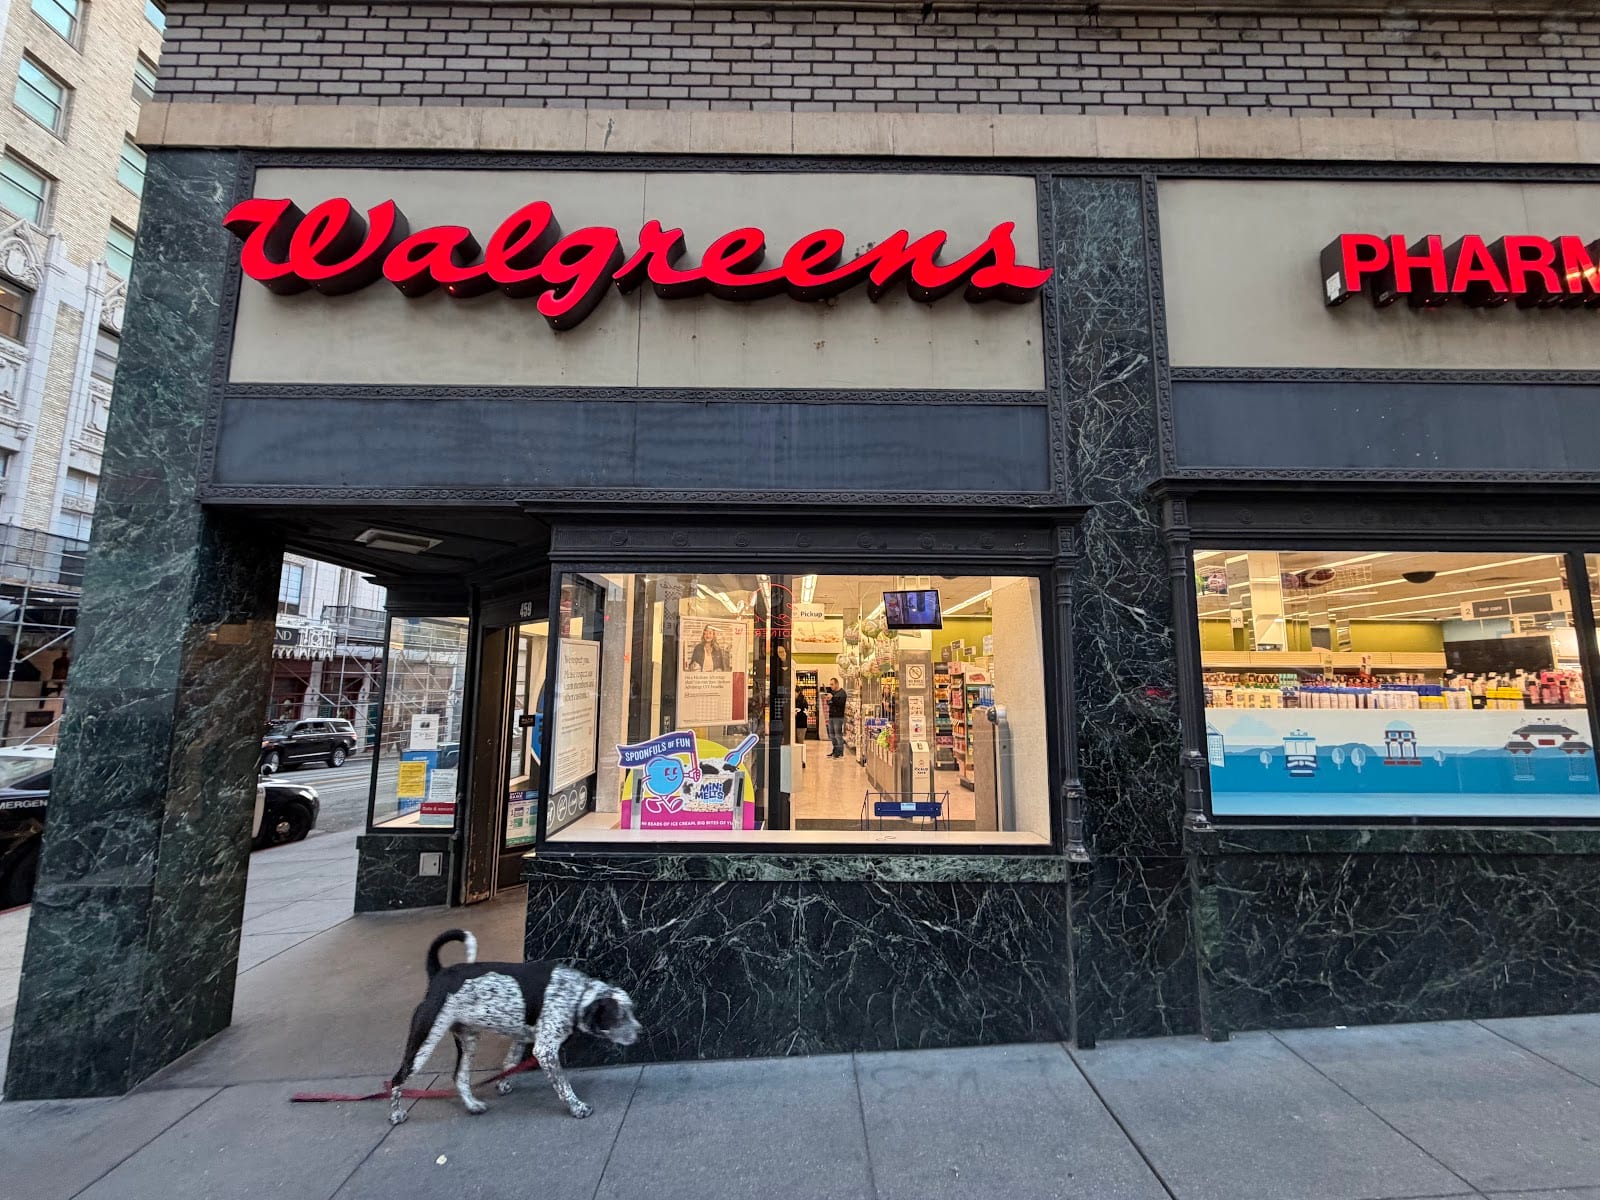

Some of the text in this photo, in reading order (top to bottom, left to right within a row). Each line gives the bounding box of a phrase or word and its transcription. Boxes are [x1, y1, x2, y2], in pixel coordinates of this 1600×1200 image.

[222, 197, 1053, 317] Walgreens
[520, 601, 532, 618] 459
[800, 610, 823, 619] Pickup
[1465, 607, 1471, 615] 2
[624, 738, 691, 762] SPOONFULS OF FUN
[695, 790, 724, 800] MELTS
